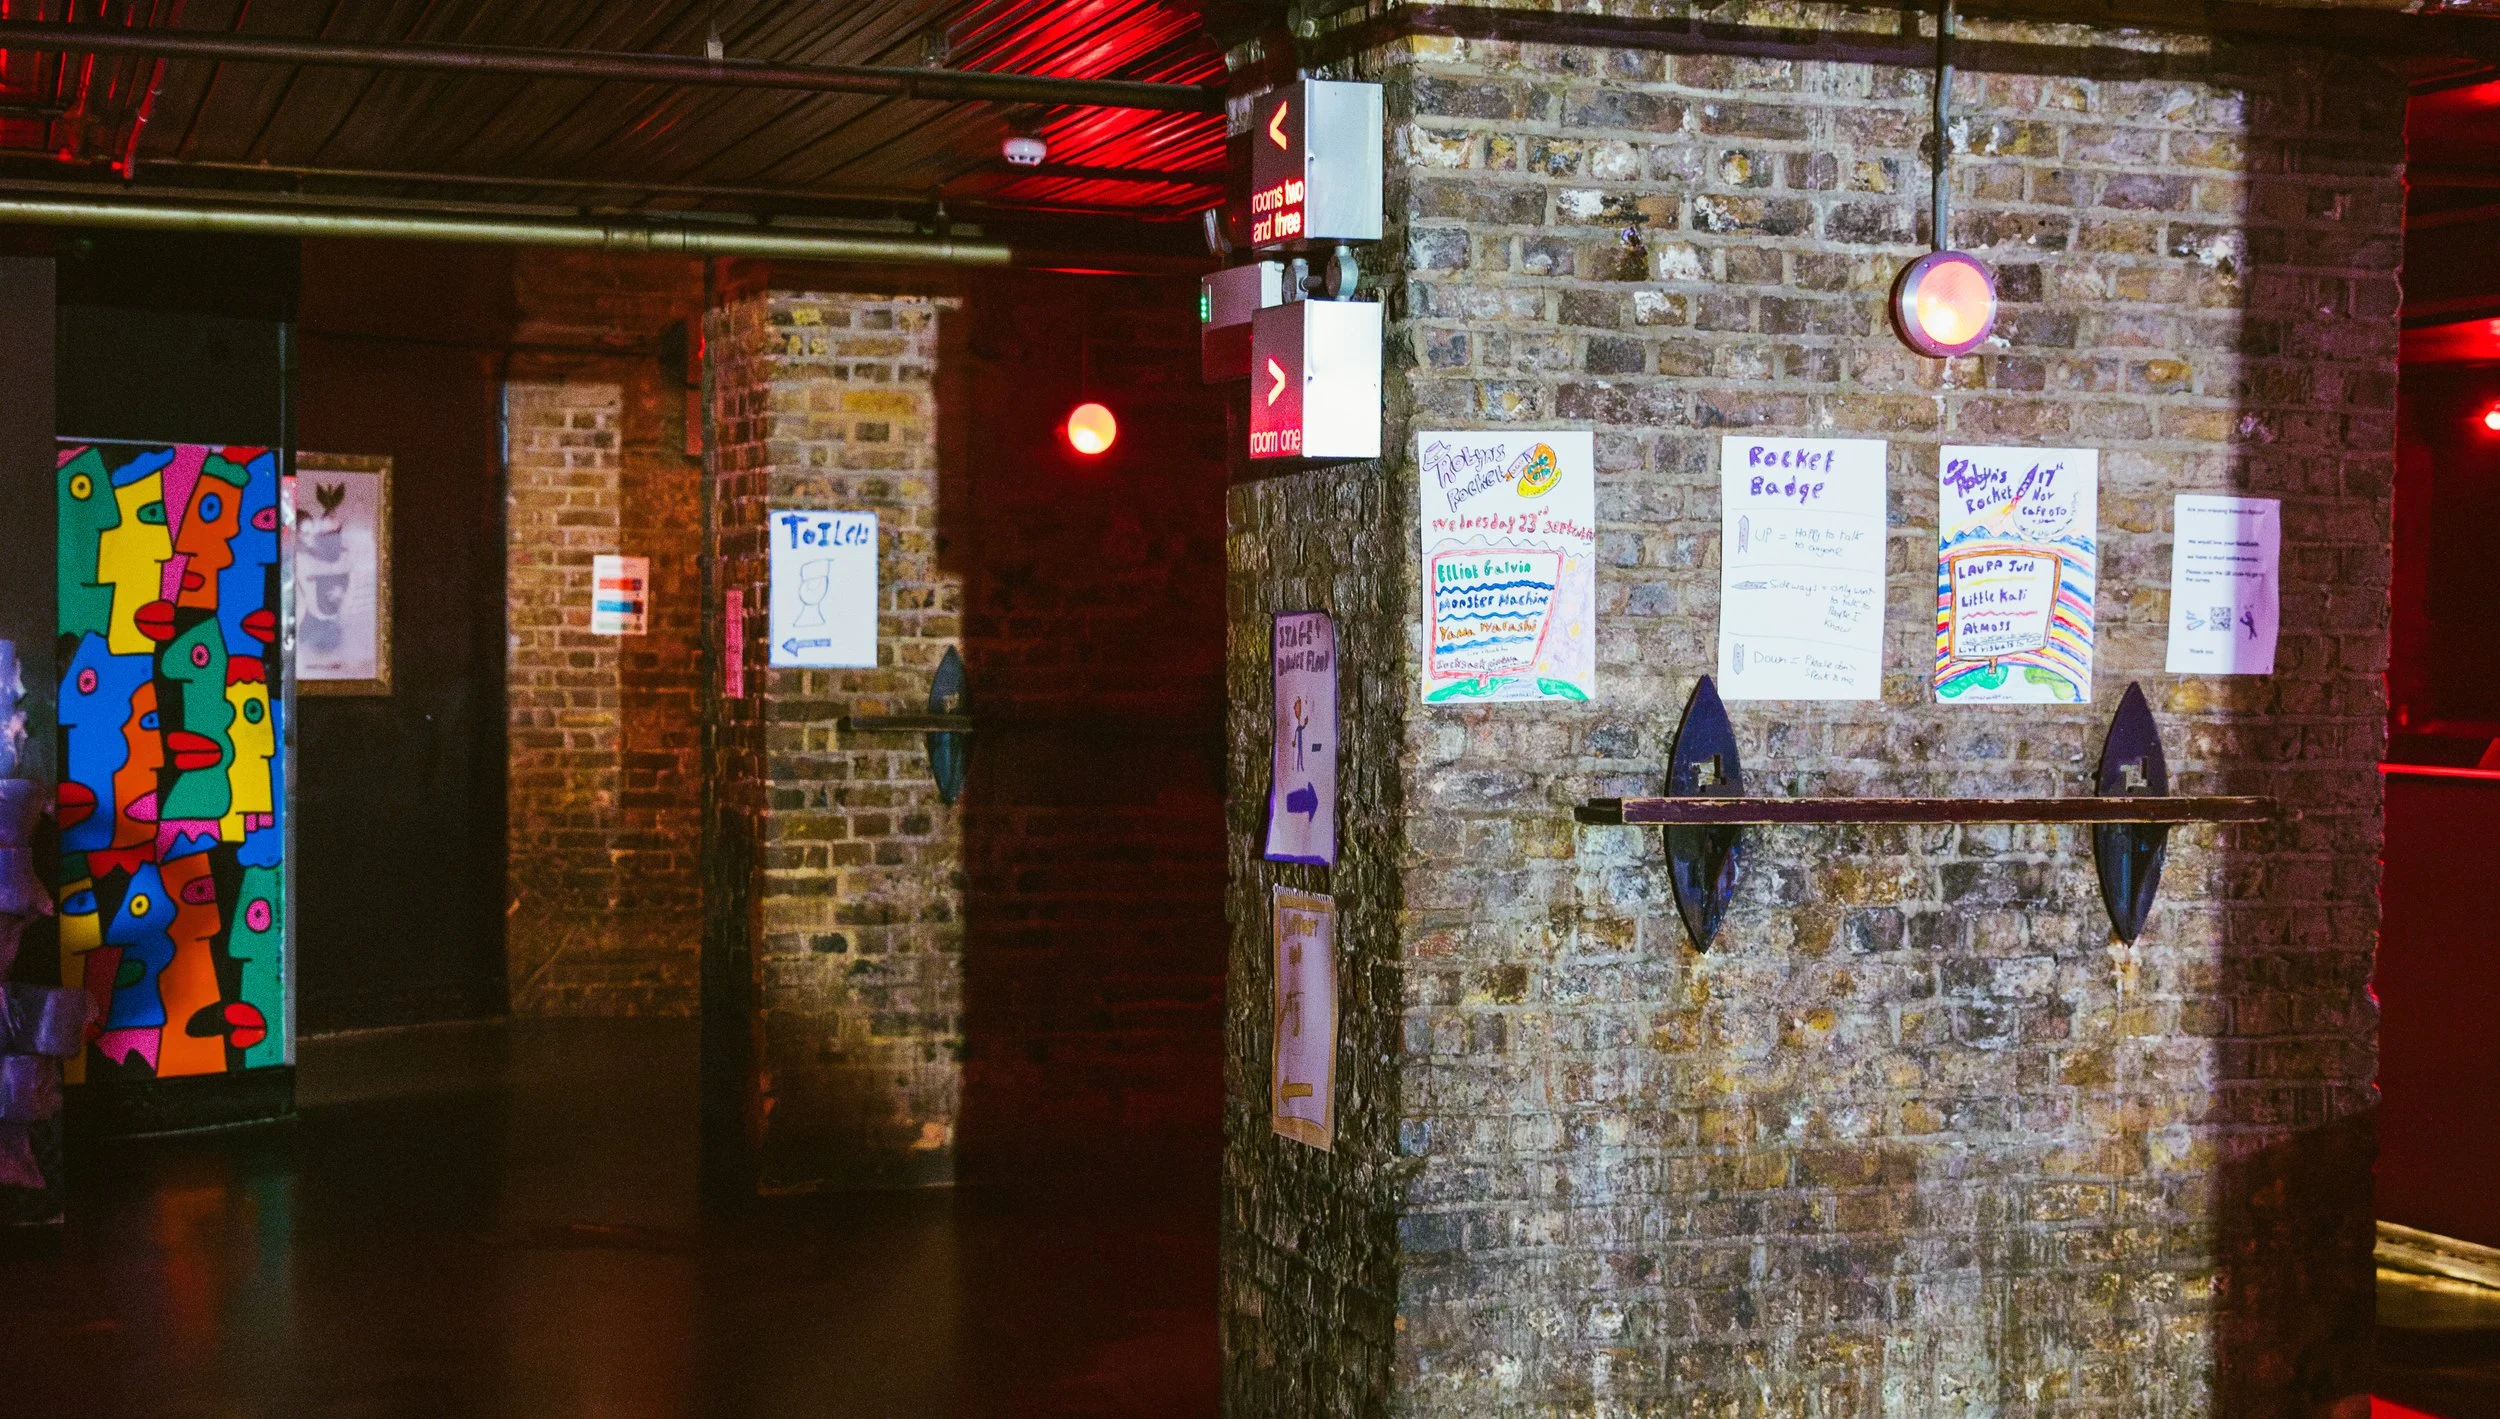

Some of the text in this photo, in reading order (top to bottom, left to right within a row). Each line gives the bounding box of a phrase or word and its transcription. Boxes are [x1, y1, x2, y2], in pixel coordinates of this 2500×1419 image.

[1252, 179, 1304, 214] rooms two
[1253, 211, 1301, 243] and three
[1250, 428, 1301, 454] room one
[1749, 446, 1835, 473] Rocket
[1750, 475, 1825, 504] Badge
[1966, 485, 2012, 515] Rocket
[1437, 563, 1479, 583] Elliot
[1439, 591, 1549, 613] Monster Machine
[1961, 590, 1994, 608] Little
